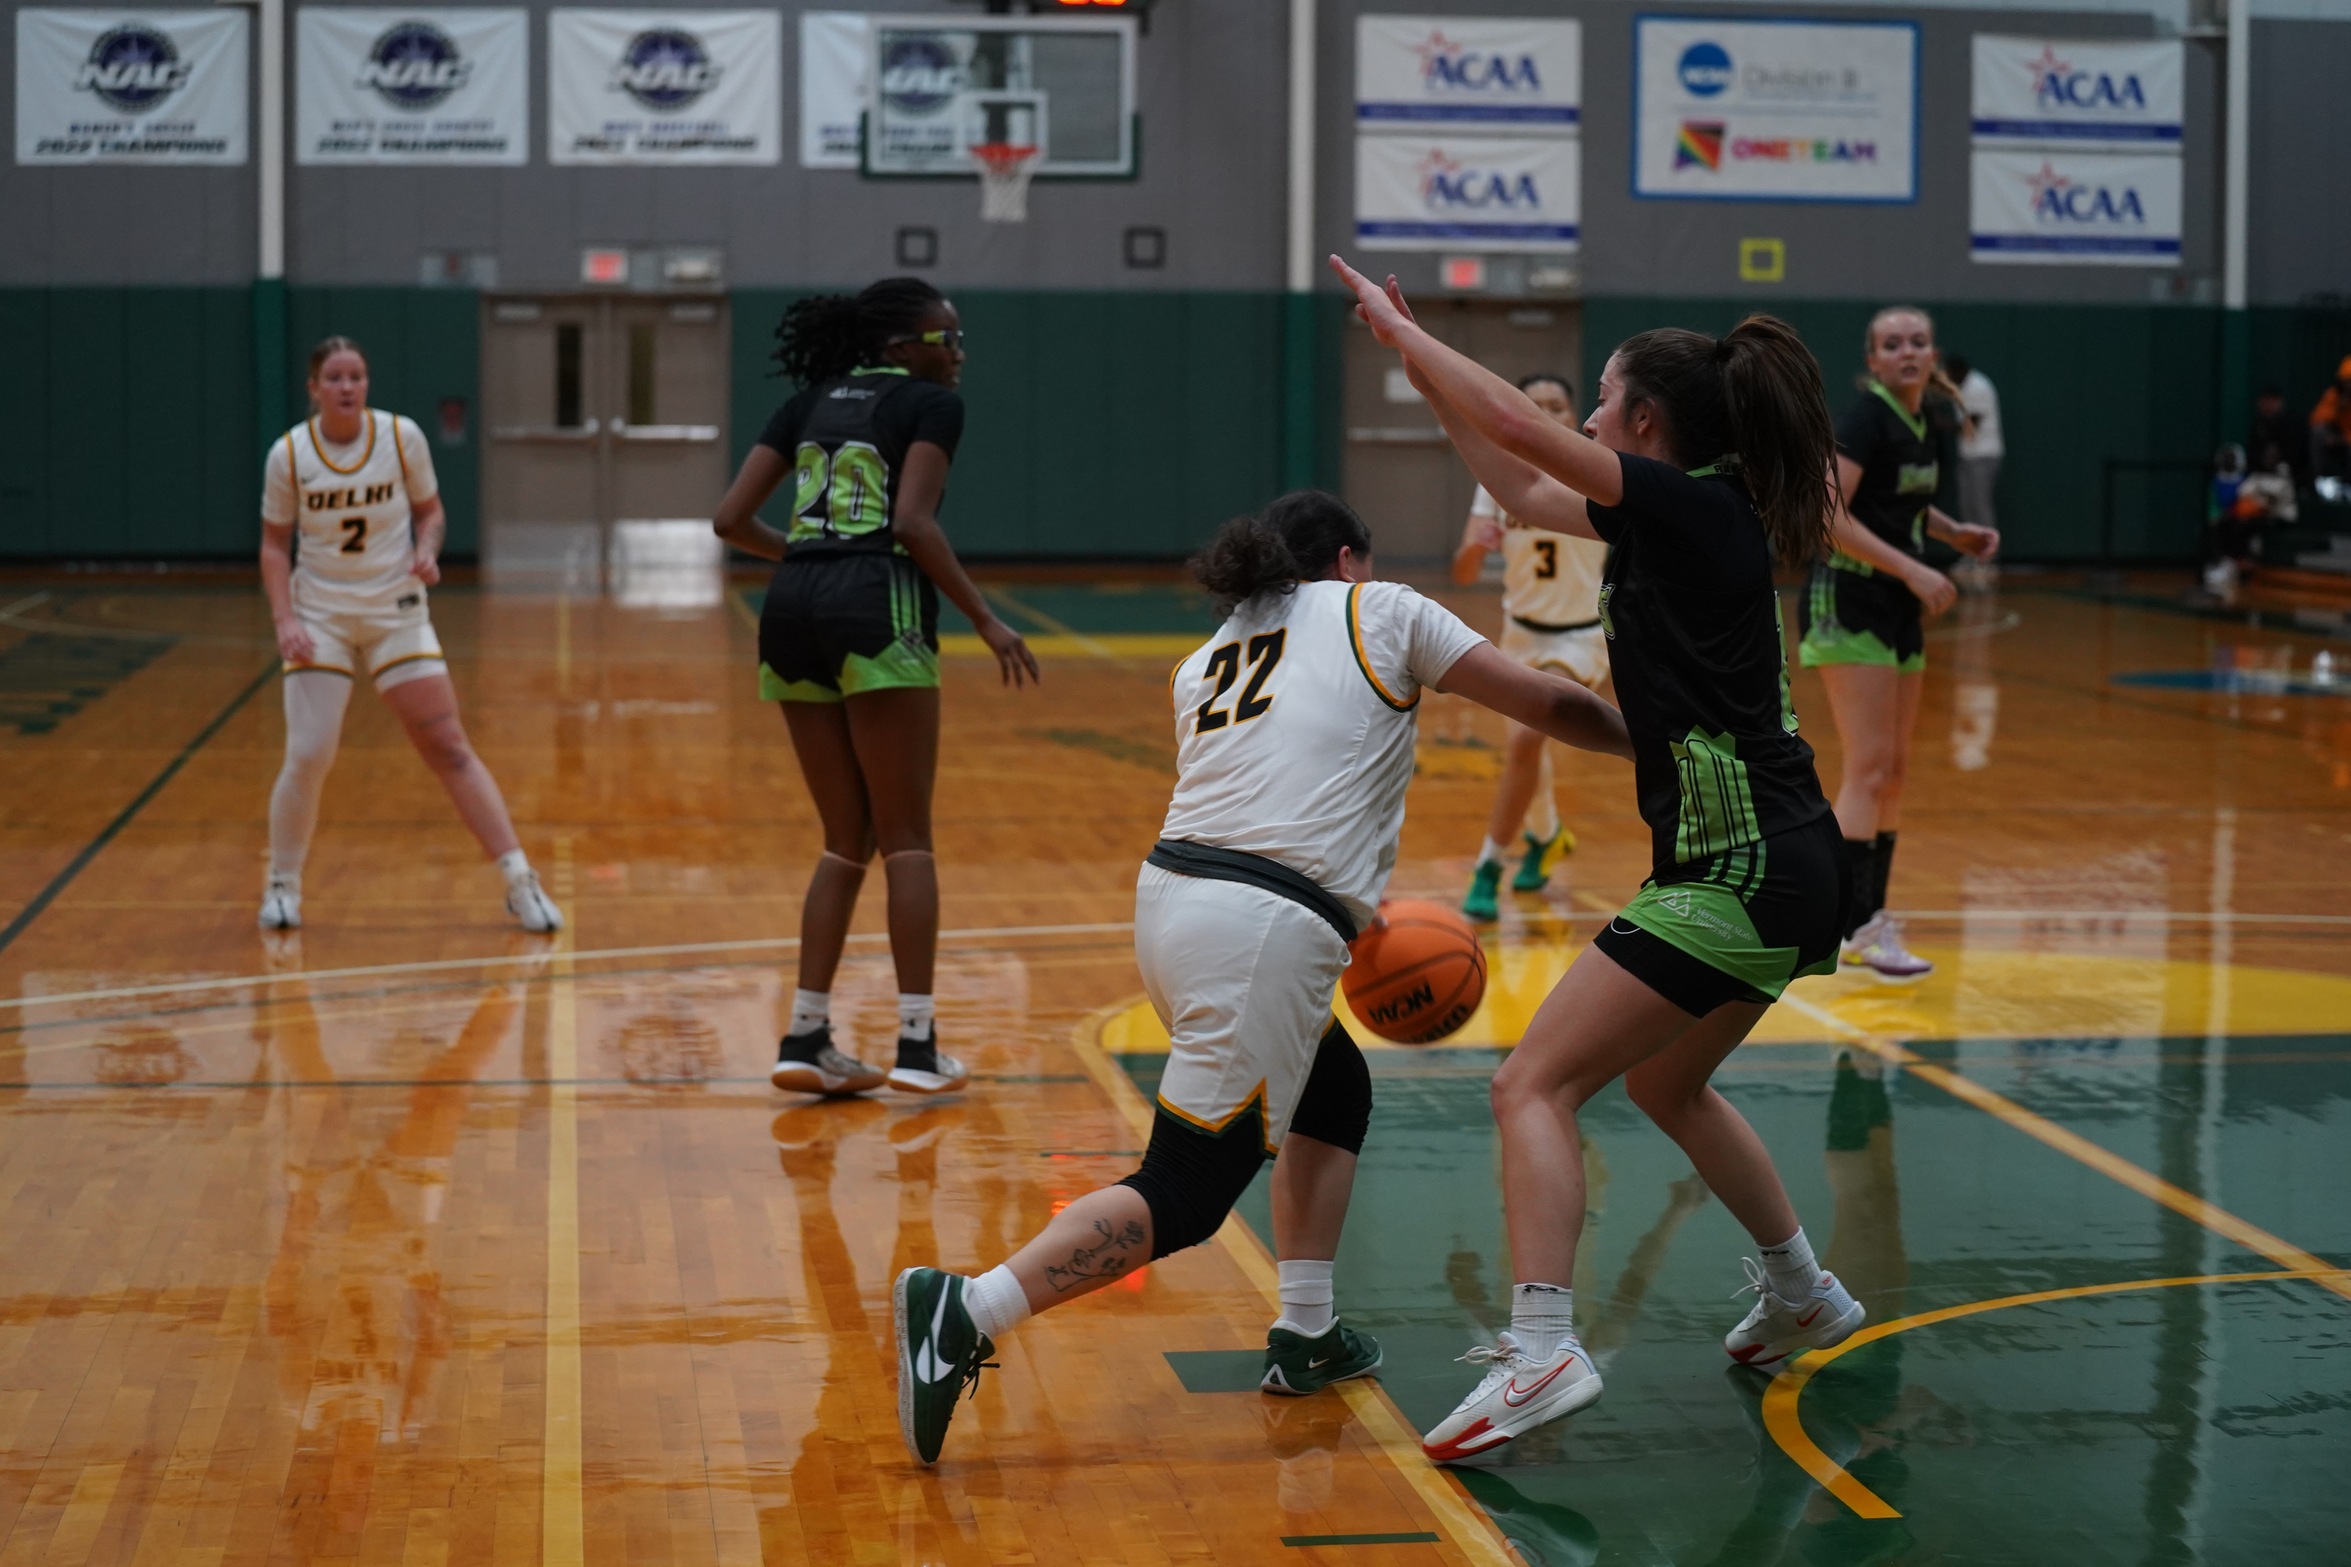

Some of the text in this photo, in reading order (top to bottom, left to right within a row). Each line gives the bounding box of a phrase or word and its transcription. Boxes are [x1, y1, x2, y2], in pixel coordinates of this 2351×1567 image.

[74, 58, 194, 92] NAC
[1425, 53, 1541, 92] ACAA
[2038, 71, 2146, 108] ACAA
[1424, 171, 1541, 209] ACAA
[2037, 186, 2145, 223] ACAA
[307, 482, 395, 512] DELHI
[787, 440, 889, 540] 20
[340, 515, 368, 554] 2
[1535, 540, 1558, 580] 3
[1195, 627, 1288, 737] 22
[1690, 913, 1733, 941] University
[1696, 906, 1754, 941] Vermont State
